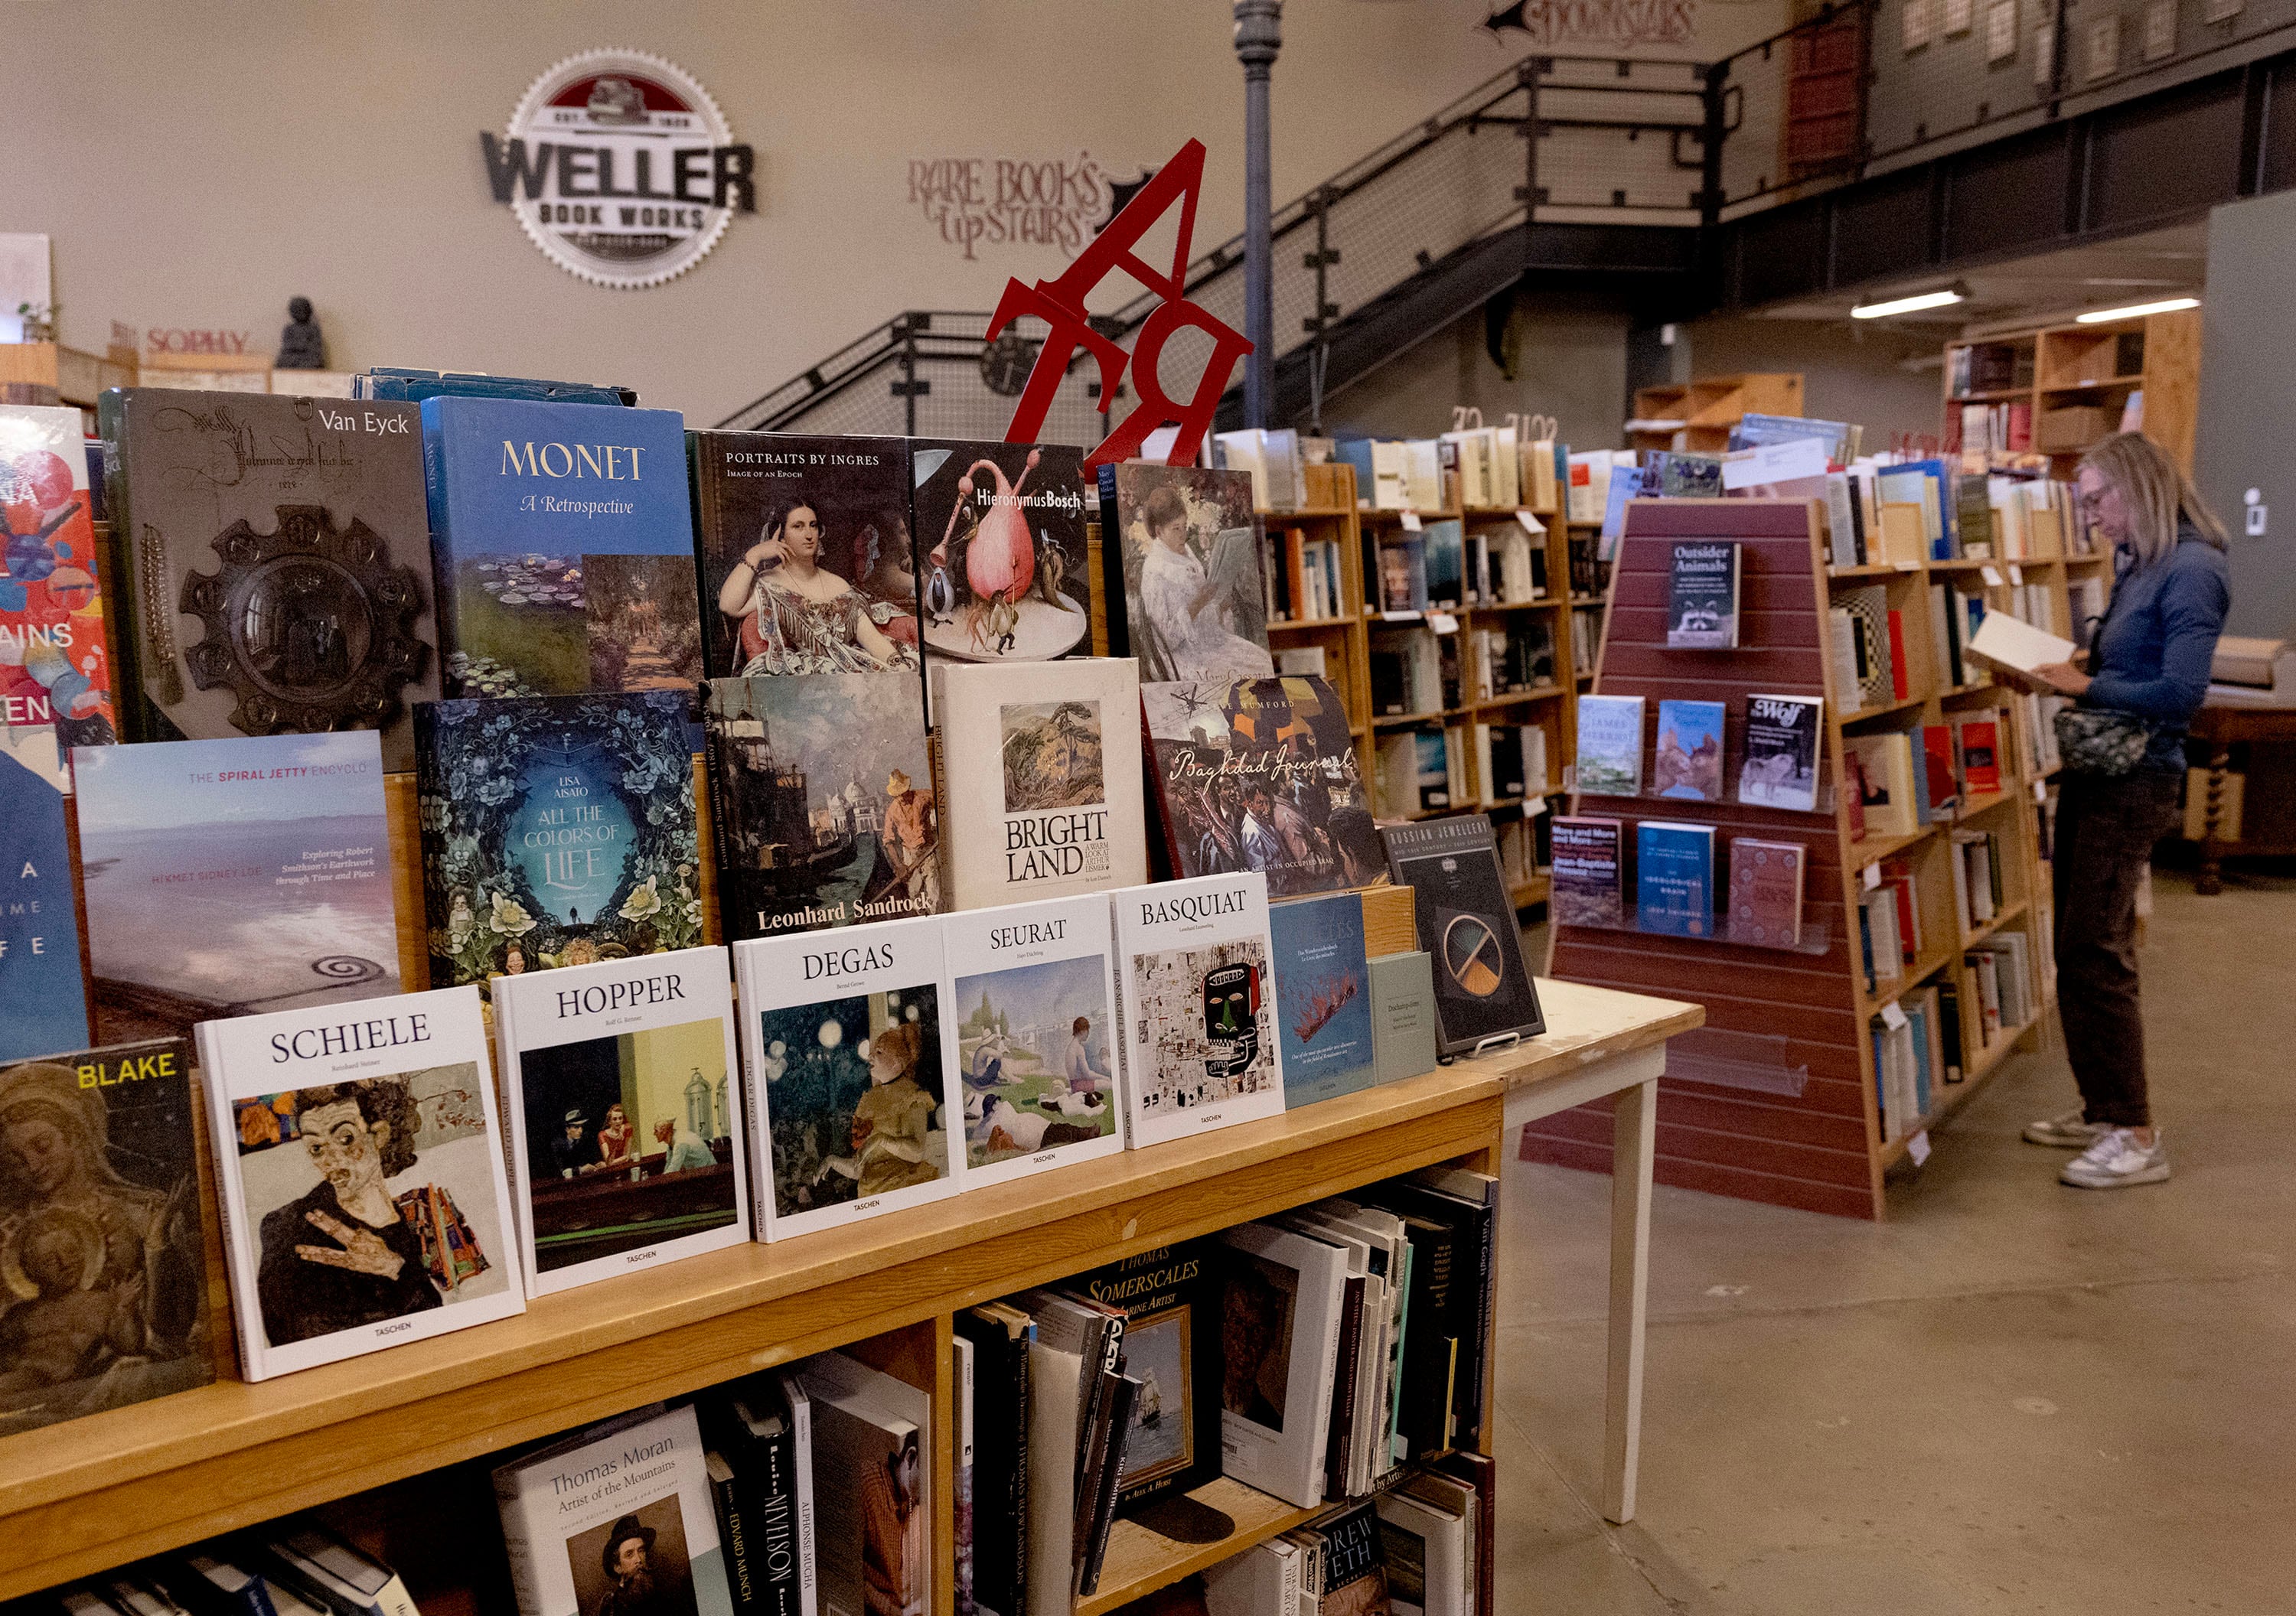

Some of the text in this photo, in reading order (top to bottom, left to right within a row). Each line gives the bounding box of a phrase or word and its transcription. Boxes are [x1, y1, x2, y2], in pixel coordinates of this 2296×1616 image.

[479, 129, 758, 216] WELLER
[538, 203, 706, 231] BOOK WORKS
[318, 409, 409, 437] Van Eyck
[499, 439, 647, 481] MONET
[726, 451, 879, 466] PORTRAITS BY INGRES
[520, 495, 634, 520] A Retrospective
[1674, 545, 1730, 559] Outsider
[1675, 559, 1727, 573] Animals
[1241, 700, 1295, 710] MUMFORD
[1755, 699, 1805, 728] Wolf
[934, 725, 944, 774] BRIGHT
[189, 771, 214, 784] THE
[218, 768, 266, 783] SPIRAL
[269, 766, 308, 780] JETTY
[559, 776, 581, 787] LISA
[1169, 743, 1354, 795] Baghdad Journal
[553, 787, 589, 799] AISATO
[937, 777, 947, 816] LAND
[538, 805, 606, 826] ALL THE
[524, 824, 620, 849] COLORS OF
[1003, 810, 1109, 851] BRIGHT
[1389, 821, 1489, 845] RUSSIAN JEWELLERY
[281, 857, 374, 874] Smithson's Earthwork
[302, 845, 373, 862] Exploring Robert
[1006, 845, 1084, 883] LAND
[1285, 858, 1317, 869] OCCUPIED
[1319, 856, 1335, 866] IRAQ
[21, 861, 38, 878] A
[152, 871, 195, 885] HIKMET
[275, 868, 376, 887] through Time and Place
[544, 848, 606, 891] LIFE
[758, 892, 933, 931] Leonhard Sandrock
[1140, 890, 1247, 926] BASQUIAT
[990, 918, 1068, 950] SEURAT
[803, 943, 894, 981] DEGAS
[556, 973, 687, 1019] HOPPER
[271, 1013, 432, 1064] SCHIELE
[1118, 1031, 1128, 1072] BASQUIAT
[77, 1052, 178, 1090] BLAKE
[1200, 1113, 1221, 1123] TASCHEN
[1032, 1152, 1056, 1164] TASCHEN
[853, 1199, 880, 1211] TASCHEN
[1482, 1217, 1491, 1243] Van
[626, 1249, 657, 1264] TASCHEN
[1479, 1246, 1489, 1276] Gogh
[1090, 1259, 1199, 1304] SOMERSCALES
[1148, 1292, 1177, 1311] ARTIST
[374, 1321, 413, 1337] TASCHEN
[550, 1436, 673, 1496] Thomas Moran
[770, 1445, 778, 1495] Louise
[1017, 1445, 1026, 1496] THOMAS
[1117, 1456, 1127, 1477] KIKI
[557, 1458, 676, 1515] Artist of the Mountains
[1109, 1478, 1122, 1508] SMITH
[729, 1513, 744, 1557] EDVARD
[801, 1500, 812, 1590] ALPHONSE MUCHA
[1016, 1498, 1026, 1585] ROWLANDSON
[736, 1559, 752, 1603] MUNCH
